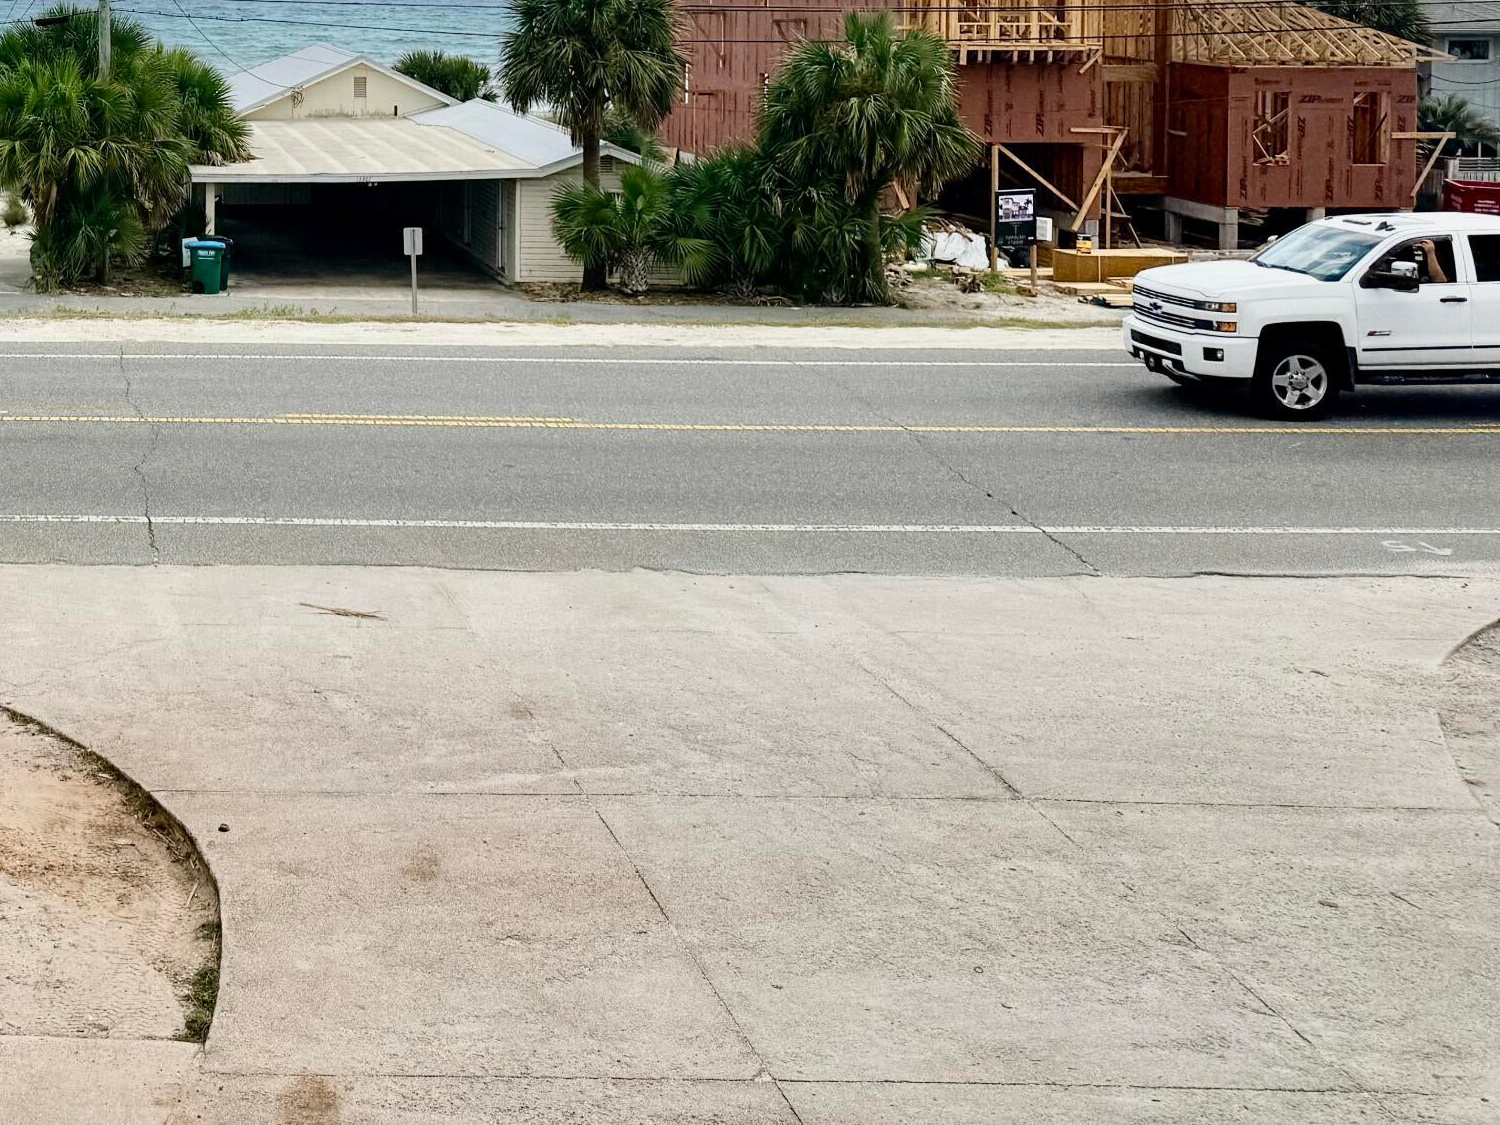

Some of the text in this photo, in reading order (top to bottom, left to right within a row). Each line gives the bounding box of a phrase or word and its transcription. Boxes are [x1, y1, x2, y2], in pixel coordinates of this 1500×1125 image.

[1299, 95, 1321, 103] ZIP
[984, 114, 992, 137] ZIP
[1036, 114, 1044, 137] ZIP
